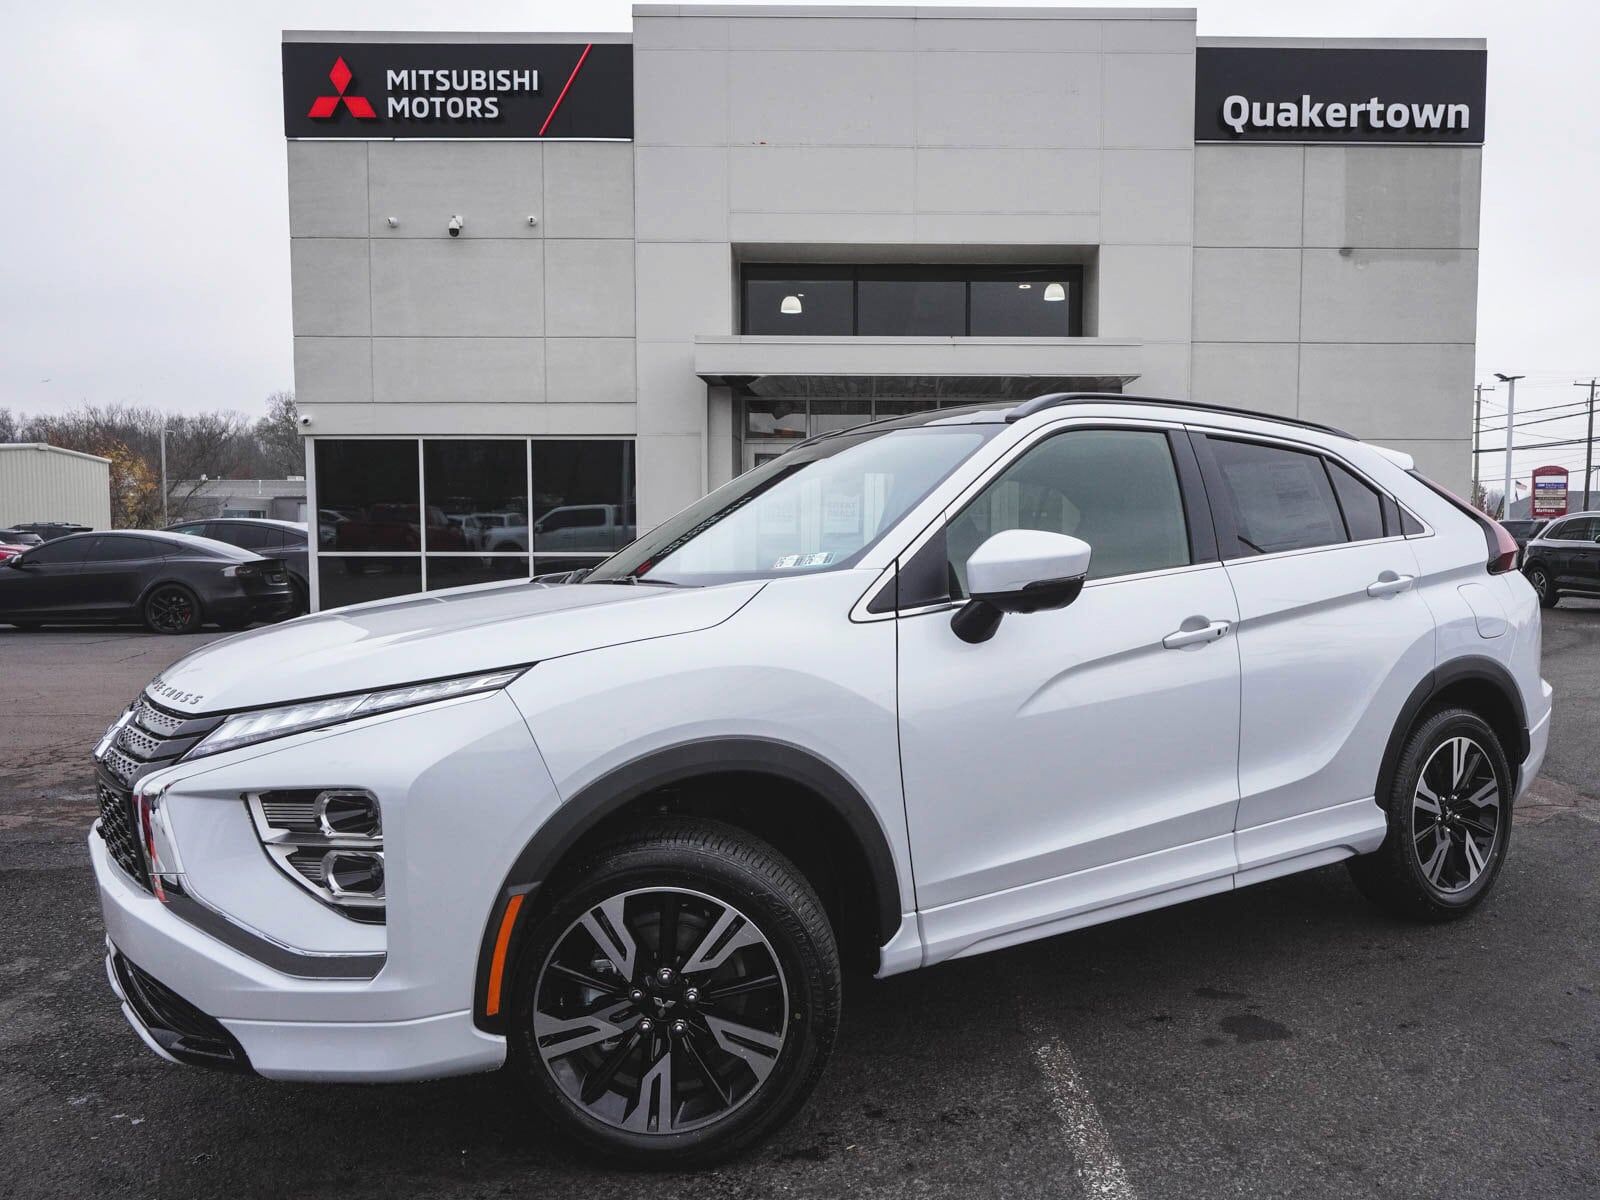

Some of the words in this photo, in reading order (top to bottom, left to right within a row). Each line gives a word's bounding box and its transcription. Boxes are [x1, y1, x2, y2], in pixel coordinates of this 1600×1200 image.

[387, 69, 539, 91] MITSUBISHI
[387, 96, 499, 119] MOTORS
[1222, 94, 1471, 134] Quakertown
[161, 687, 203, 704] CROSS
